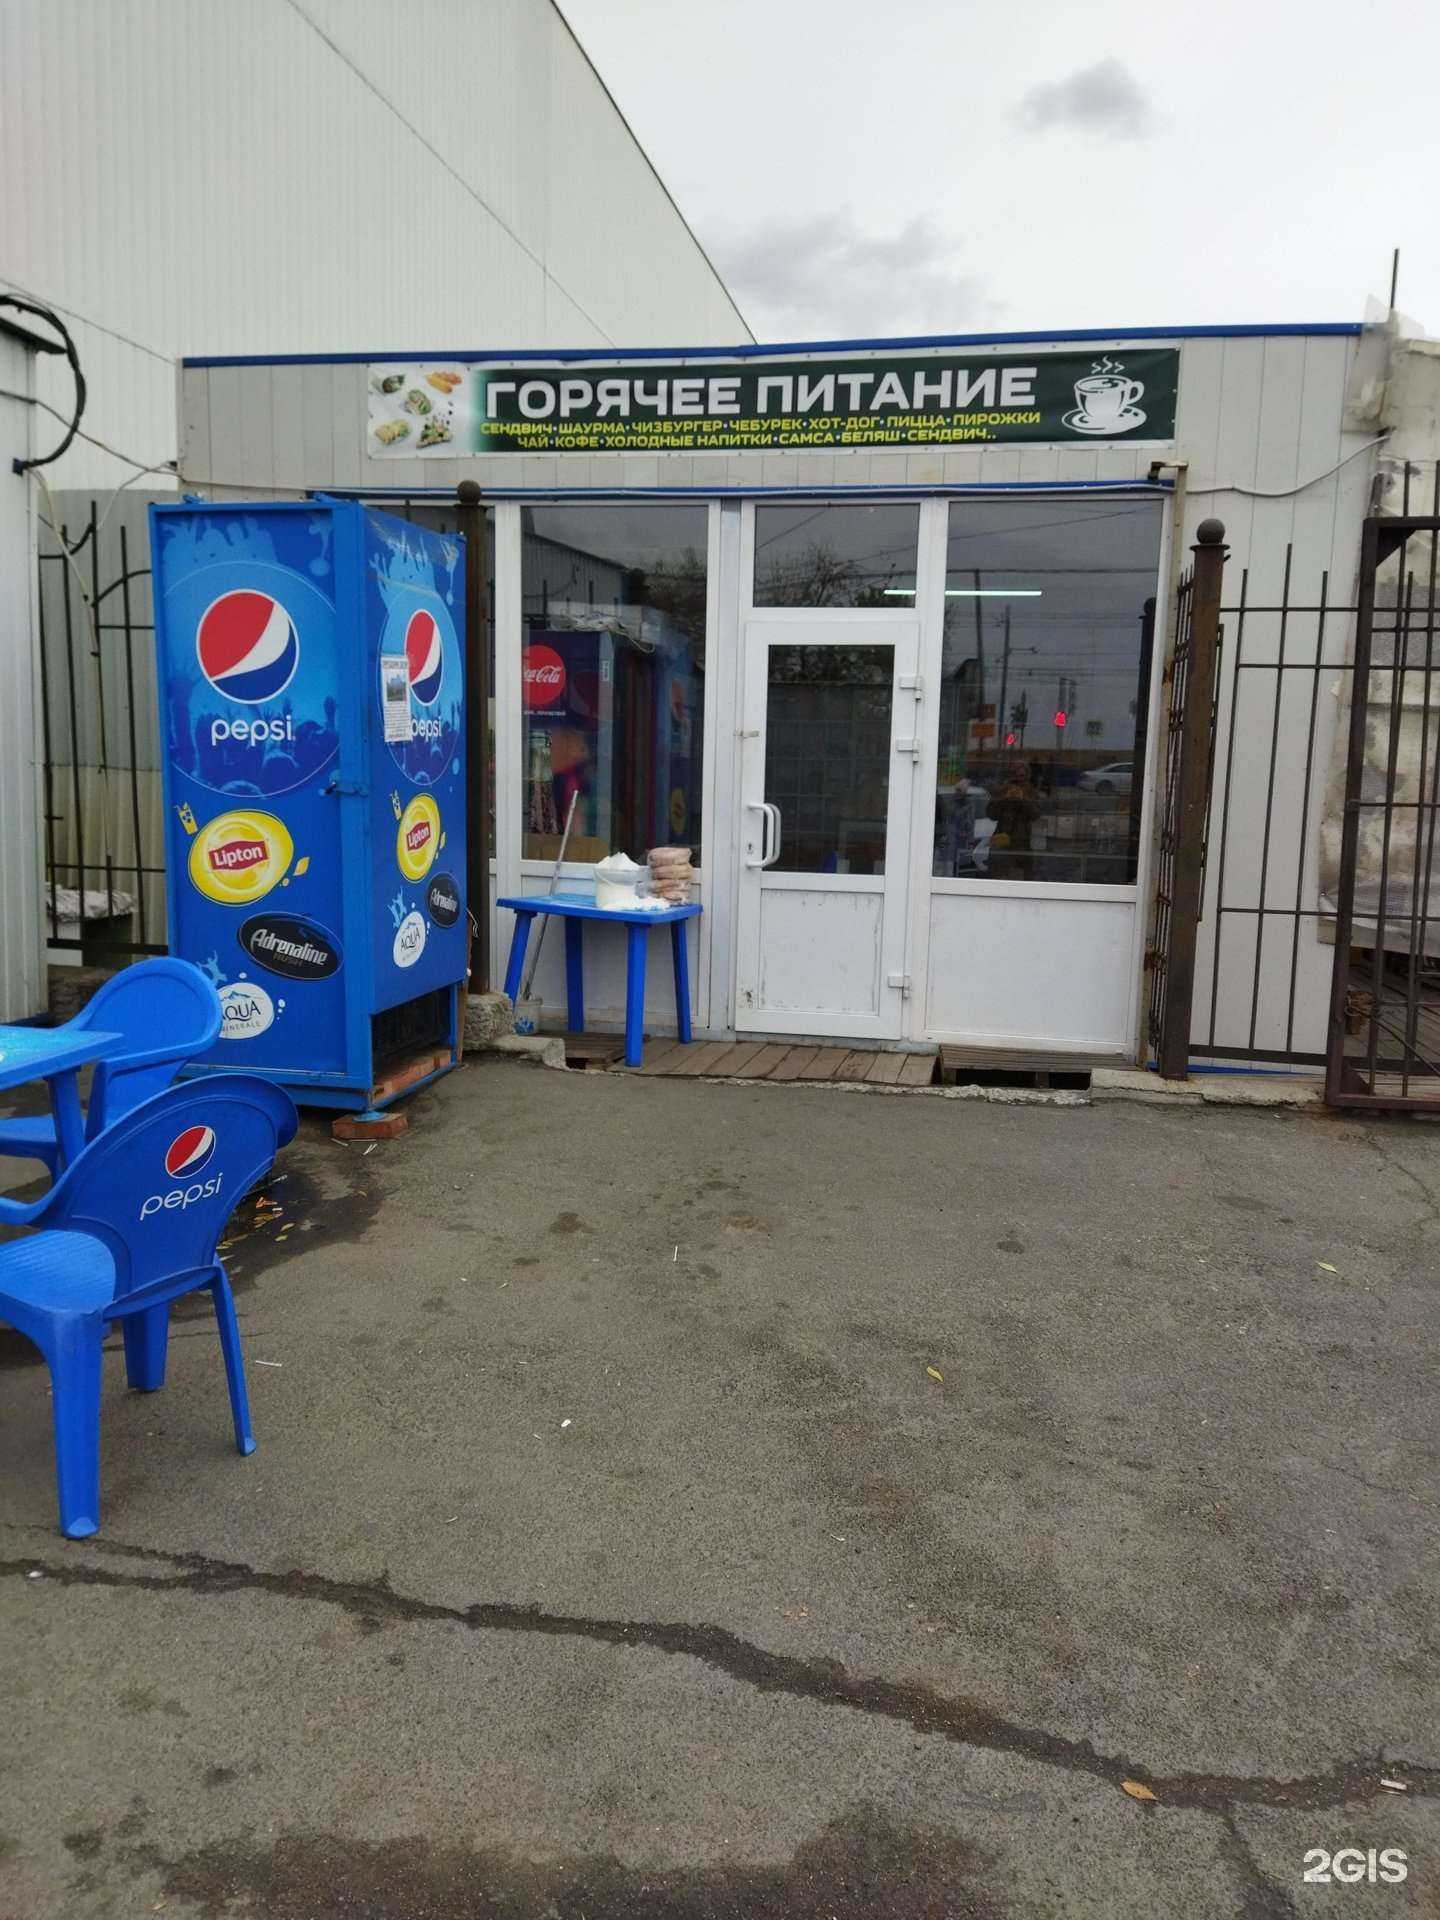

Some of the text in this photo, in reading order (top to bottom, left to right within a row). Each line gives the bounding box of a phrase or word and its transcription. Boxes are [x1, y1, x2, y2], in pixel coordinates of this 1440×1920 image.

[486, 366, 1037, 419] ГОРЯЧЕЕ ПИТАНИЕ
[480, 412, 1041, 436] СЕНДВИЧ ШАУРМА ЧИЗБУРГЕР ЧЕБУРЕК ХОТ-ДОГ ПИЦЦА ПИРОЖКИ
[517, 435, 549, 449] ЧАЙ
[555, 435, 599, 448] КОФЕ
[606, 434, 693, 448] ХОЛОДНЫЕ
[697, 433, 772, 446] НАПИТКИ
[779, 432, 834, 445] САМСА
[841, 430, 899, 443] БЕЛЯШ
[211, 714, 293, 747] pepsi
[408, 826, 430, 849] Lipton
[213, 846, 264, 868] Lipton
[250, 928, 329, 967] Adrenaline
[400, 927, 421, 952] AQUA
[222, 1000, 261, 1022] QUA
[139, 1172, 224, 1222] pepsi
